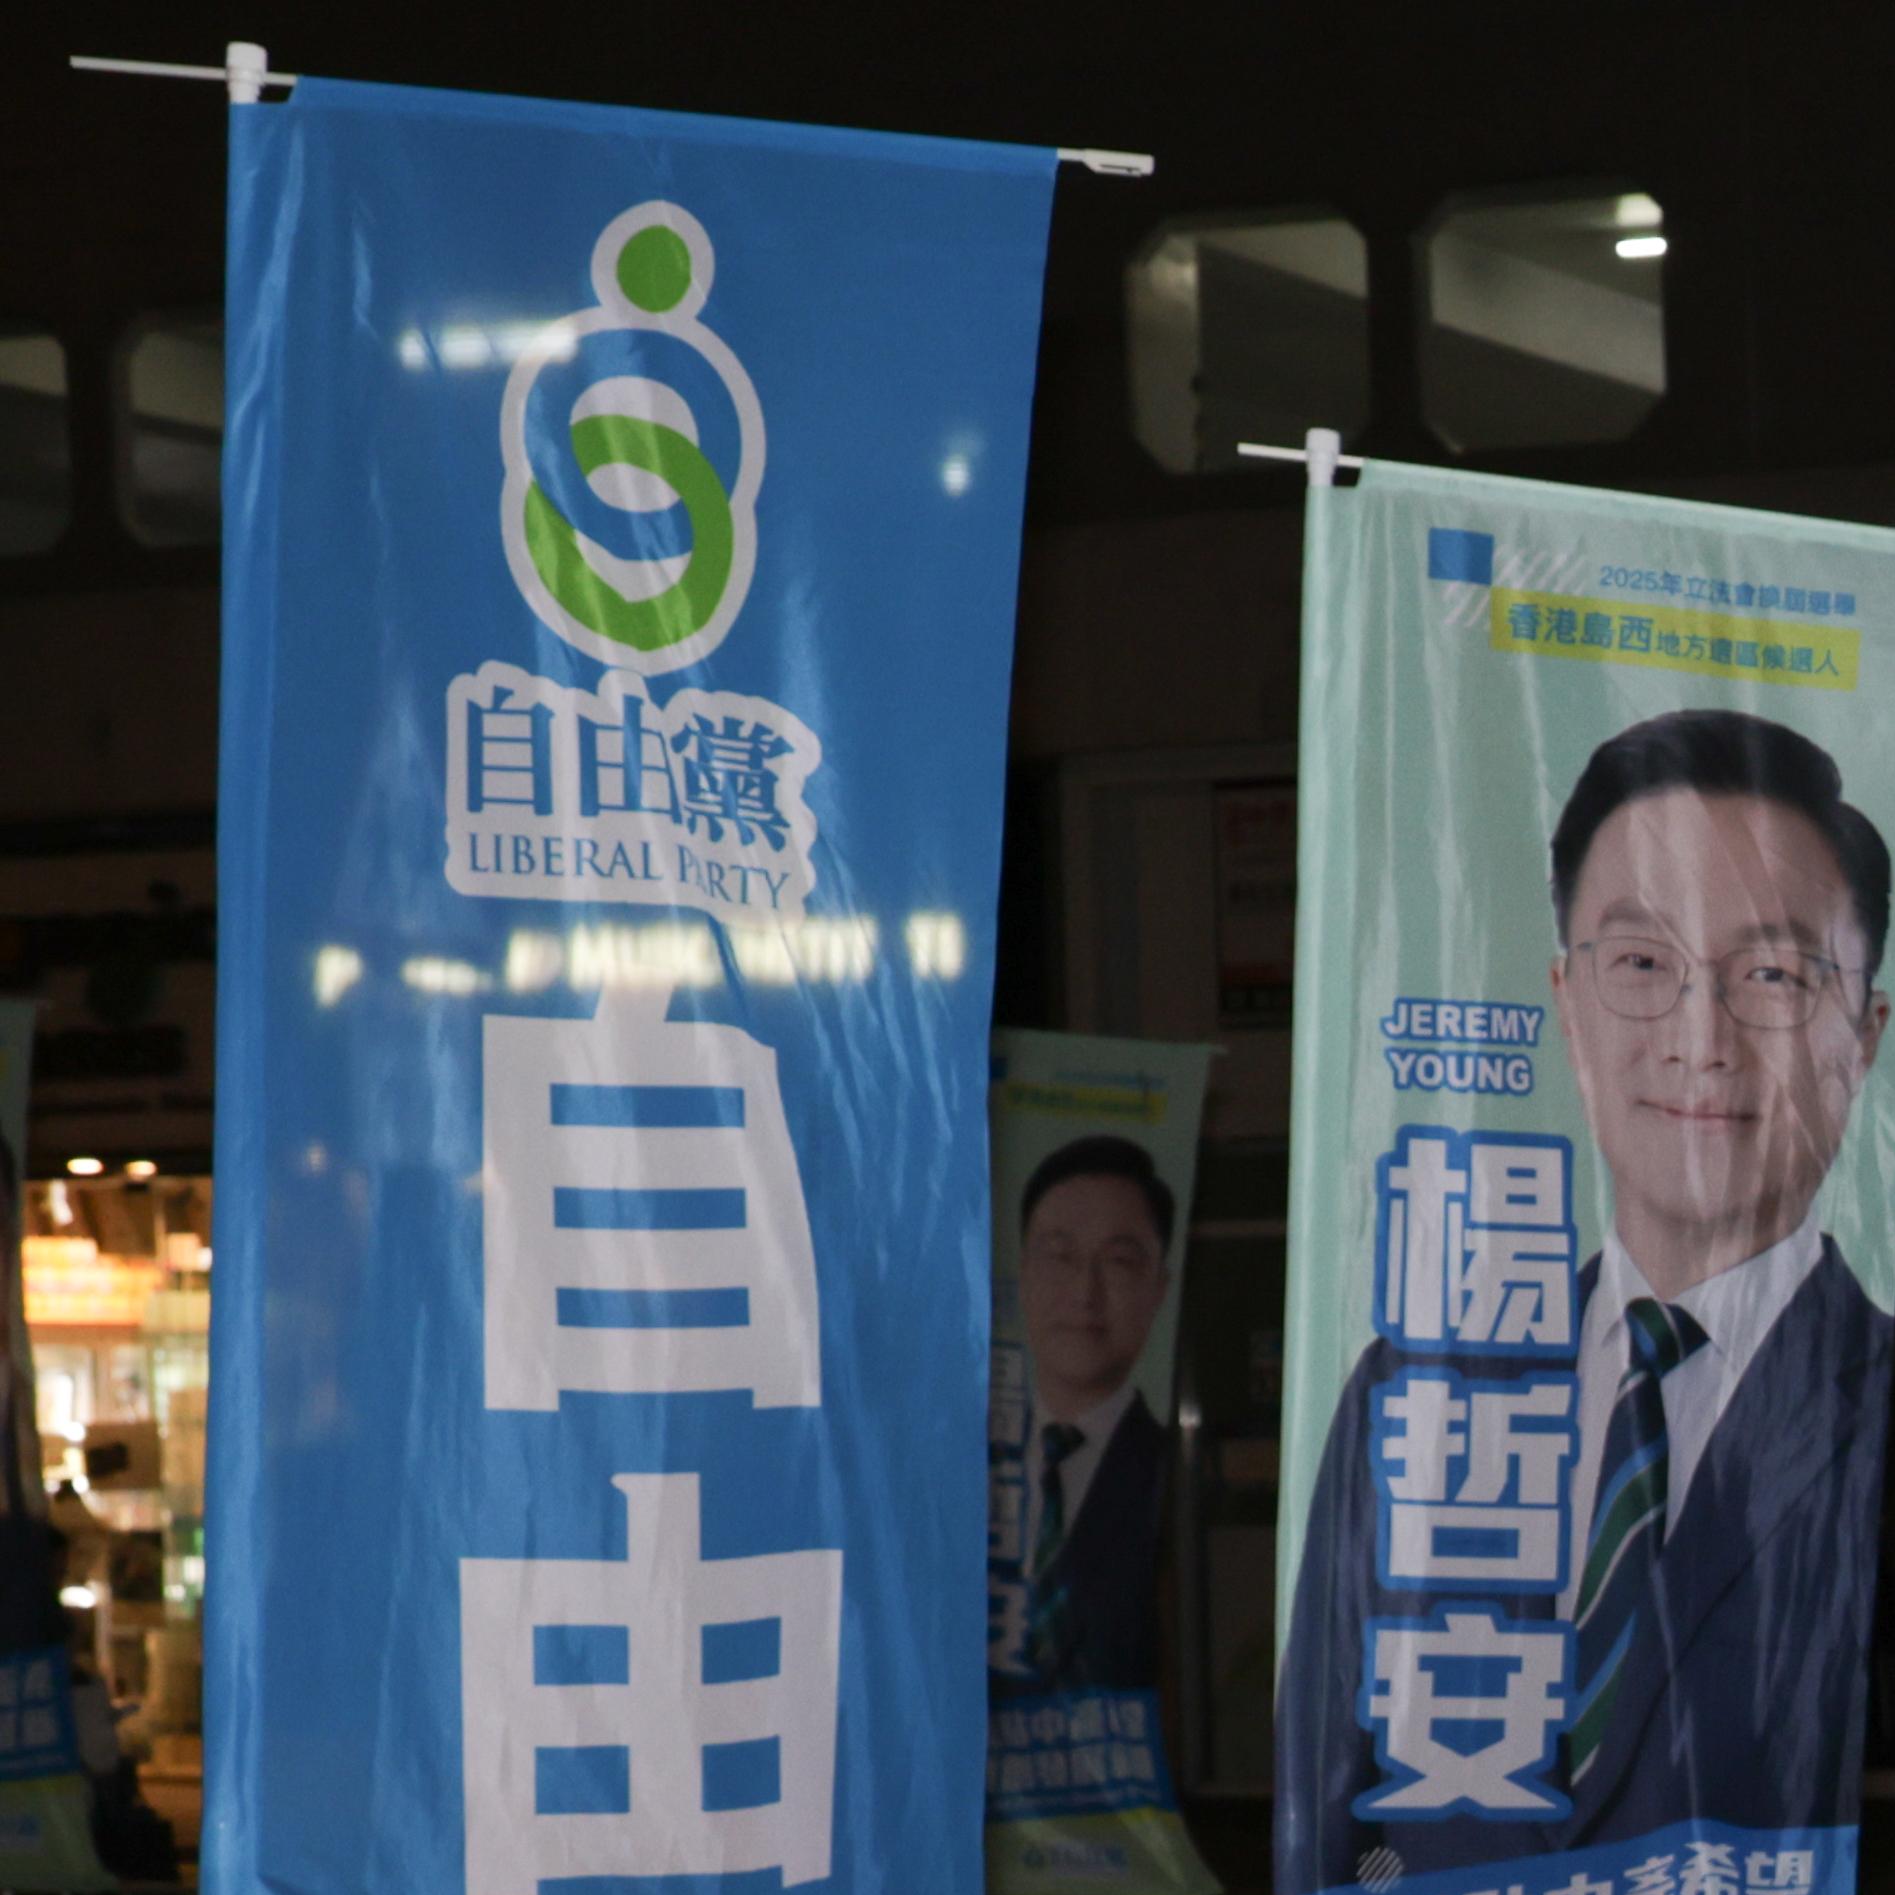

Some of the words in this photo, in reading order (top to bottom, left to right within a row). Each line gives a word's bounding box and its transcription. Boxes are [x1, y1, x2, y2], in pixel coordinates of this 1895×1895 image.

[465, 686, 796, 852] 自由黨
[467, 832, 664, 882] LIBERAL
[1382, 1002, 1543, 1044] JEREMY
[1389, 1052, 1532, 1092] YOUNG
[1368, 1136, 1573, 1810] 楊哲安
